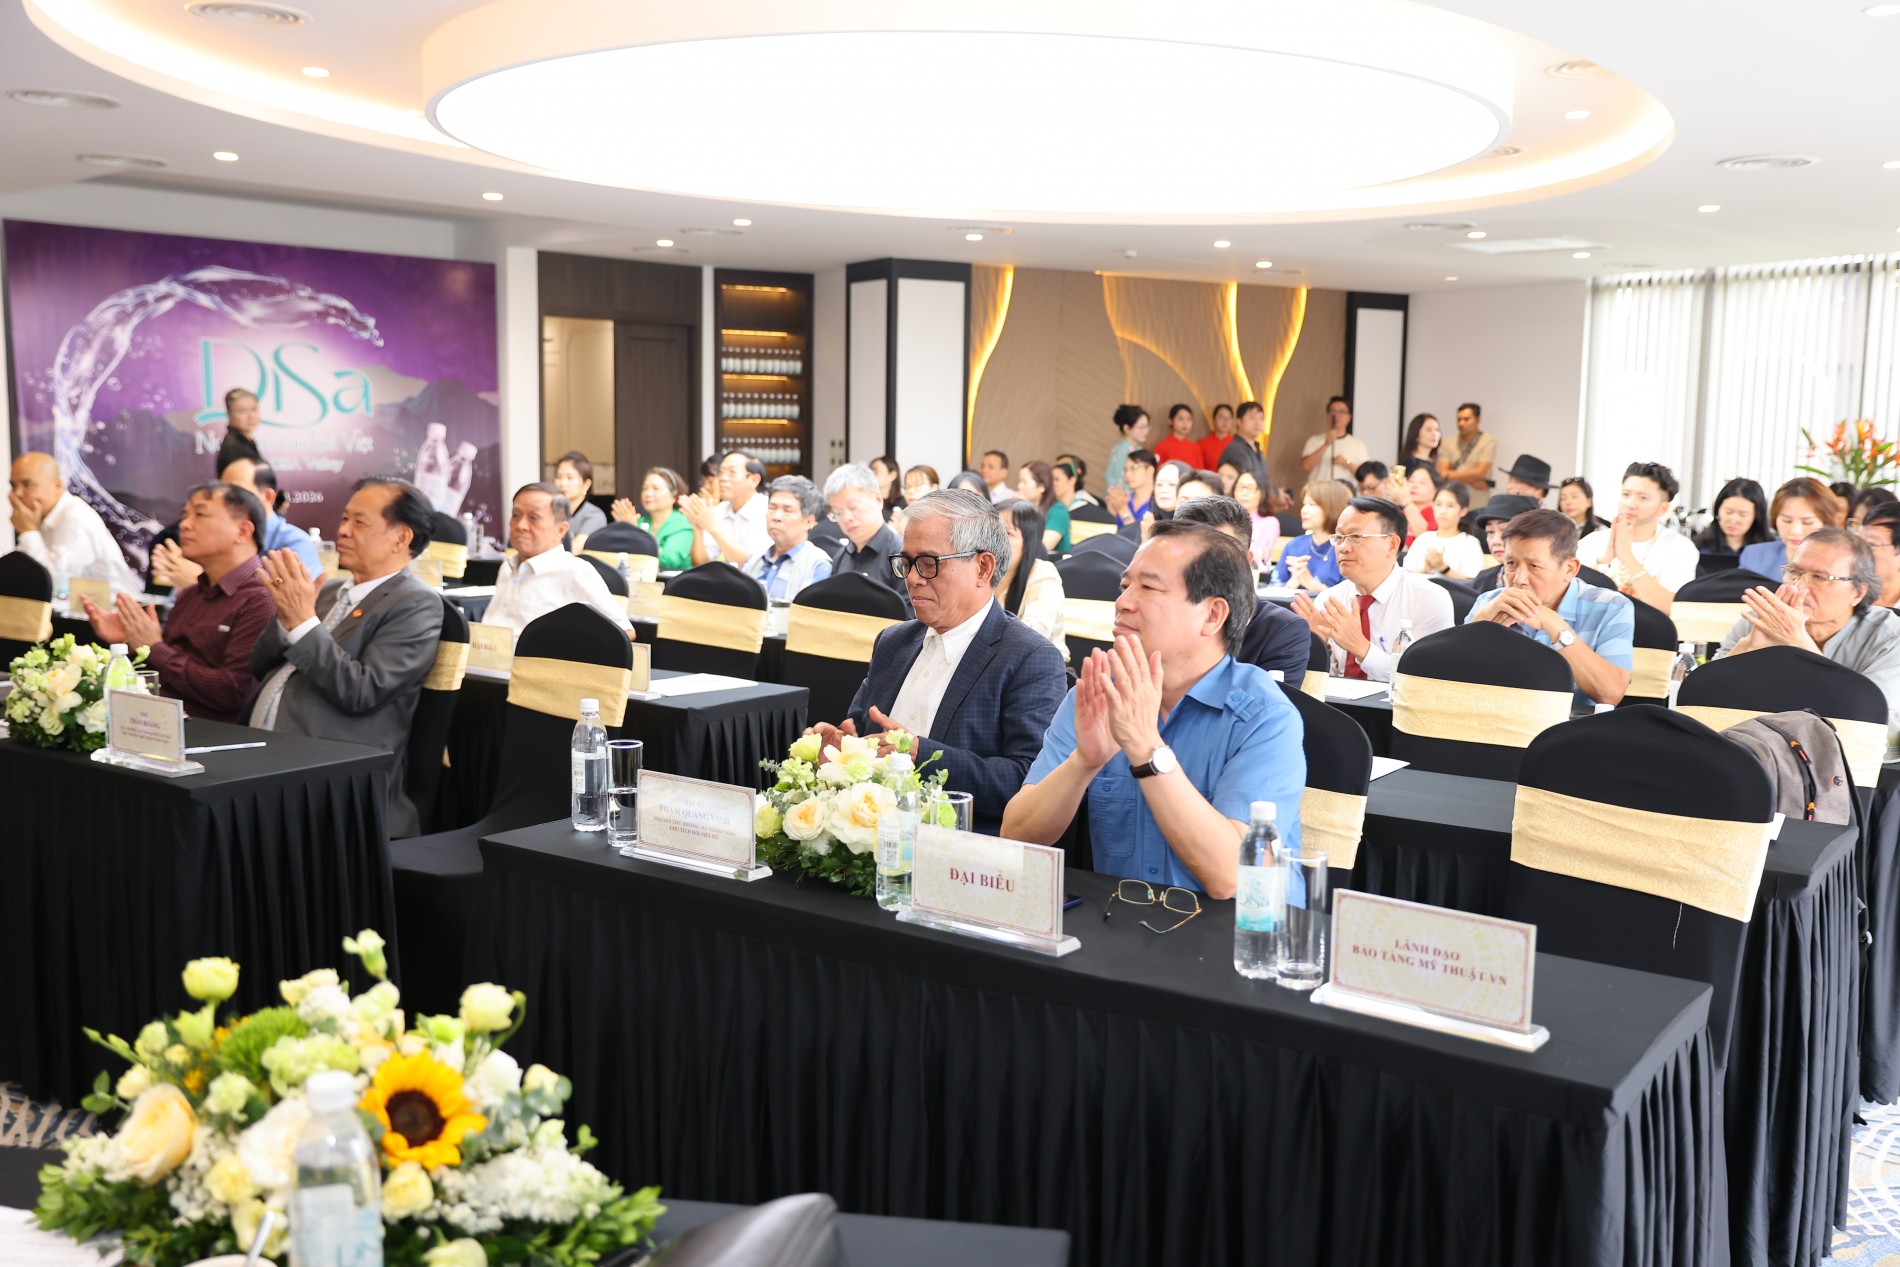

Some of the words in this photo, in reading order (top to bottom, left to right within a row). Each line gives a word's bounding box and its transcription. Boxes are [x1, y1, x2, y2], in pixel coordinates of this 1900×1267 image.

[682, 810, 710, 823] QUANG
[949, 867, 974, 886] ĐẠI
[980, 869, 1015, 893] BIỂU
[1432, 946, 1461, 962] ĐẠO
[1441, 963, 1487, 982] THUẬT
[1488, 973, 1508, 986] VN
